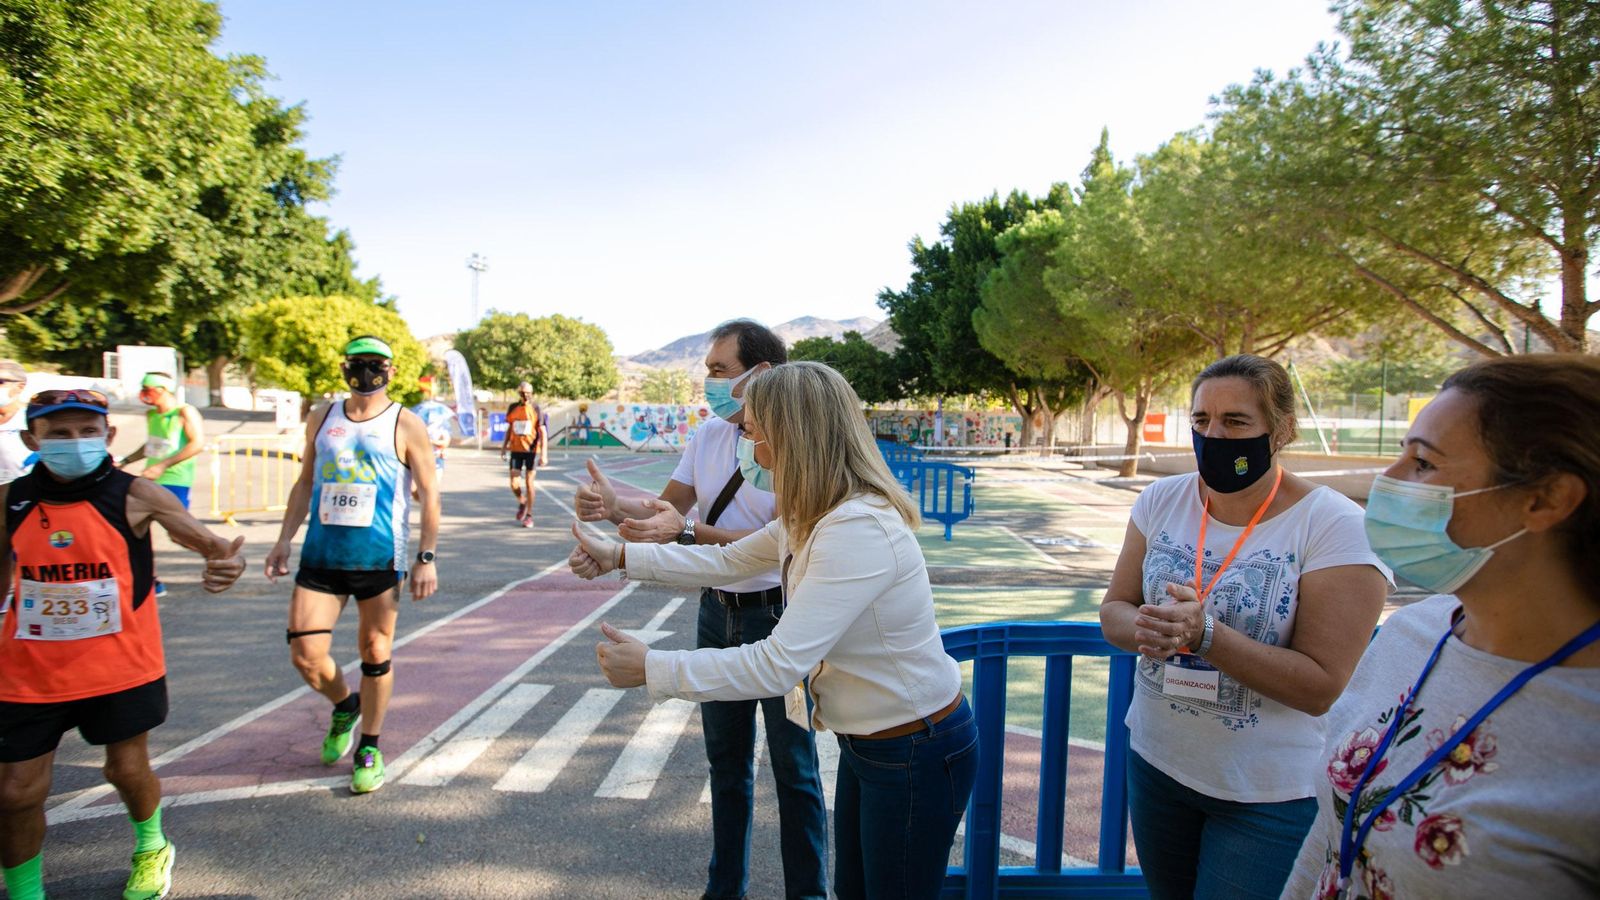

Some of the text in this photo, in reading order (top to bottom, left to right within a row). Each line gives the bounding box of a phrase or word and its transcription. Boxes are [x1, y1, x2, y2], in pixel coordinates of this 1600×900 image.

[332, 494, 358, 508] 186
[41, 599, 88, 616] 233
[1165, 677, 1216, 691] ORGANIZACIÓN
